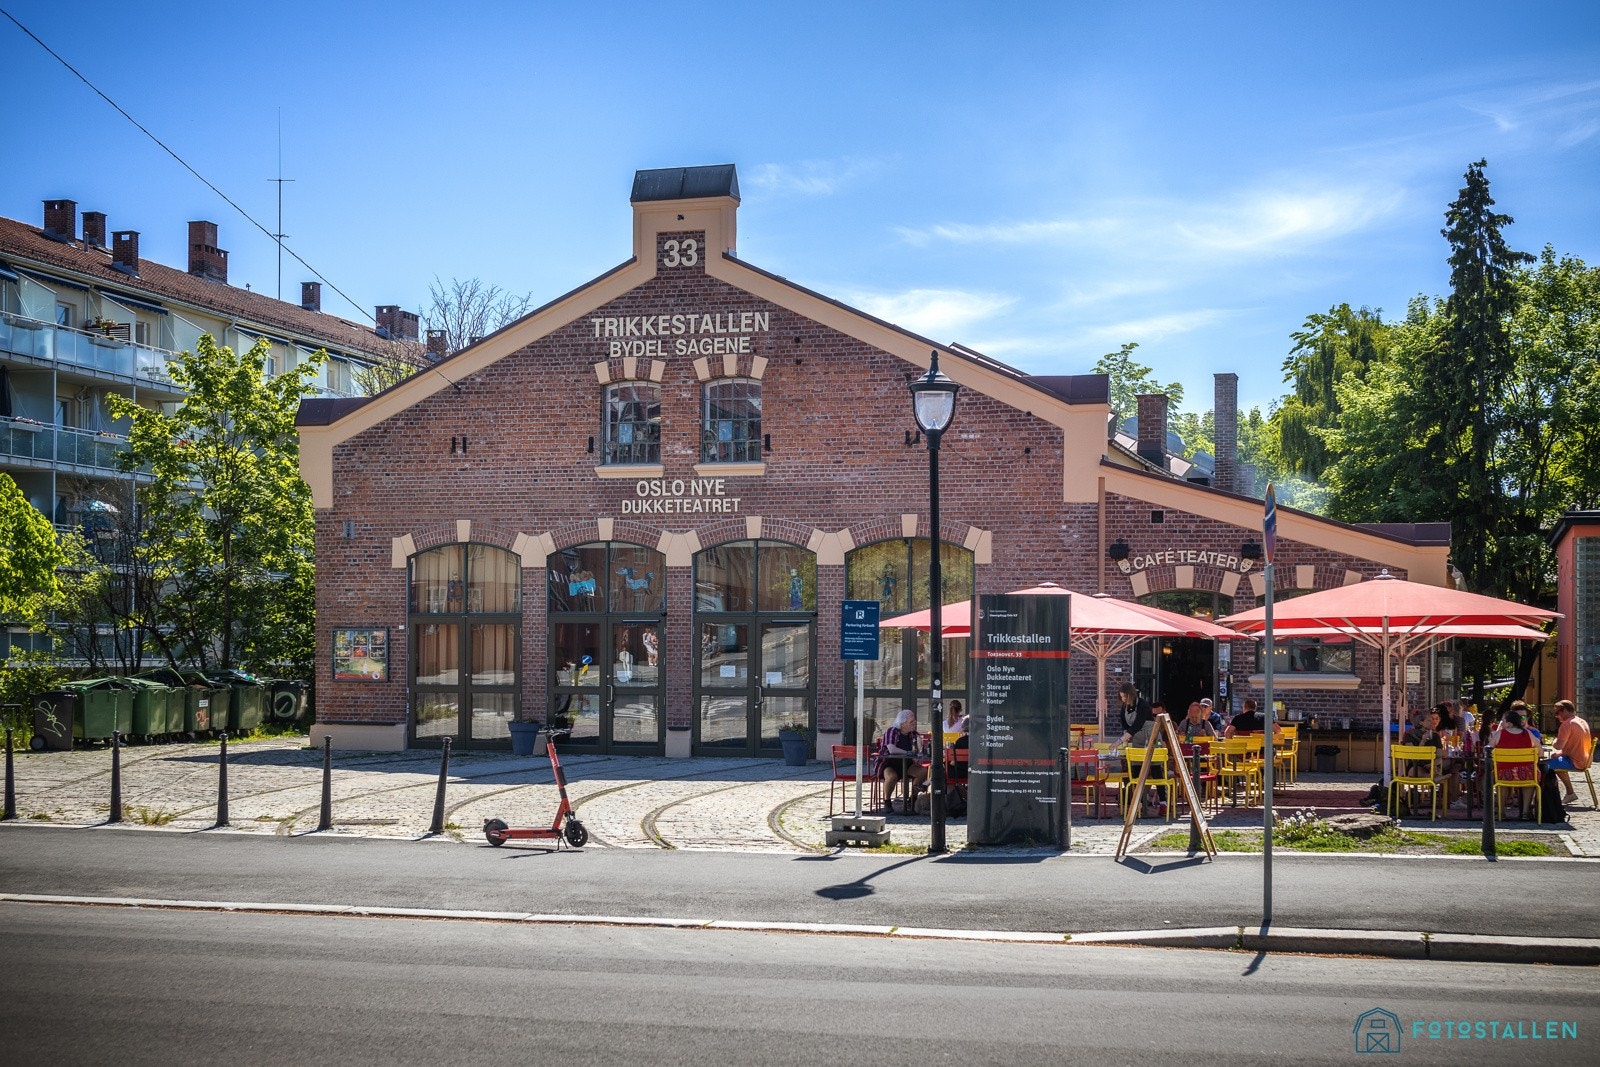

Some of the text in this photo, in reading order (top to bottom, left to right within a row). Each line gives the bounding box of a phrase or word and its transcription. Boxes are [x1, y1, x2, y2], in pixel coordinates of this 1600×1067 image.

[663, 239, 698, 267] 33
[591, 312, 769, 337] TRIKKESTALLEN
[610, 337, 750, 357] BYDEL SAGENE
[636, 479, 726, 497] OSLO NYE
[621, 498, 741, 514] DUKKETEATRET
[987, 633, 1051, 644] Trikkestallen
[1003, 665, 1015, 673] Nye
